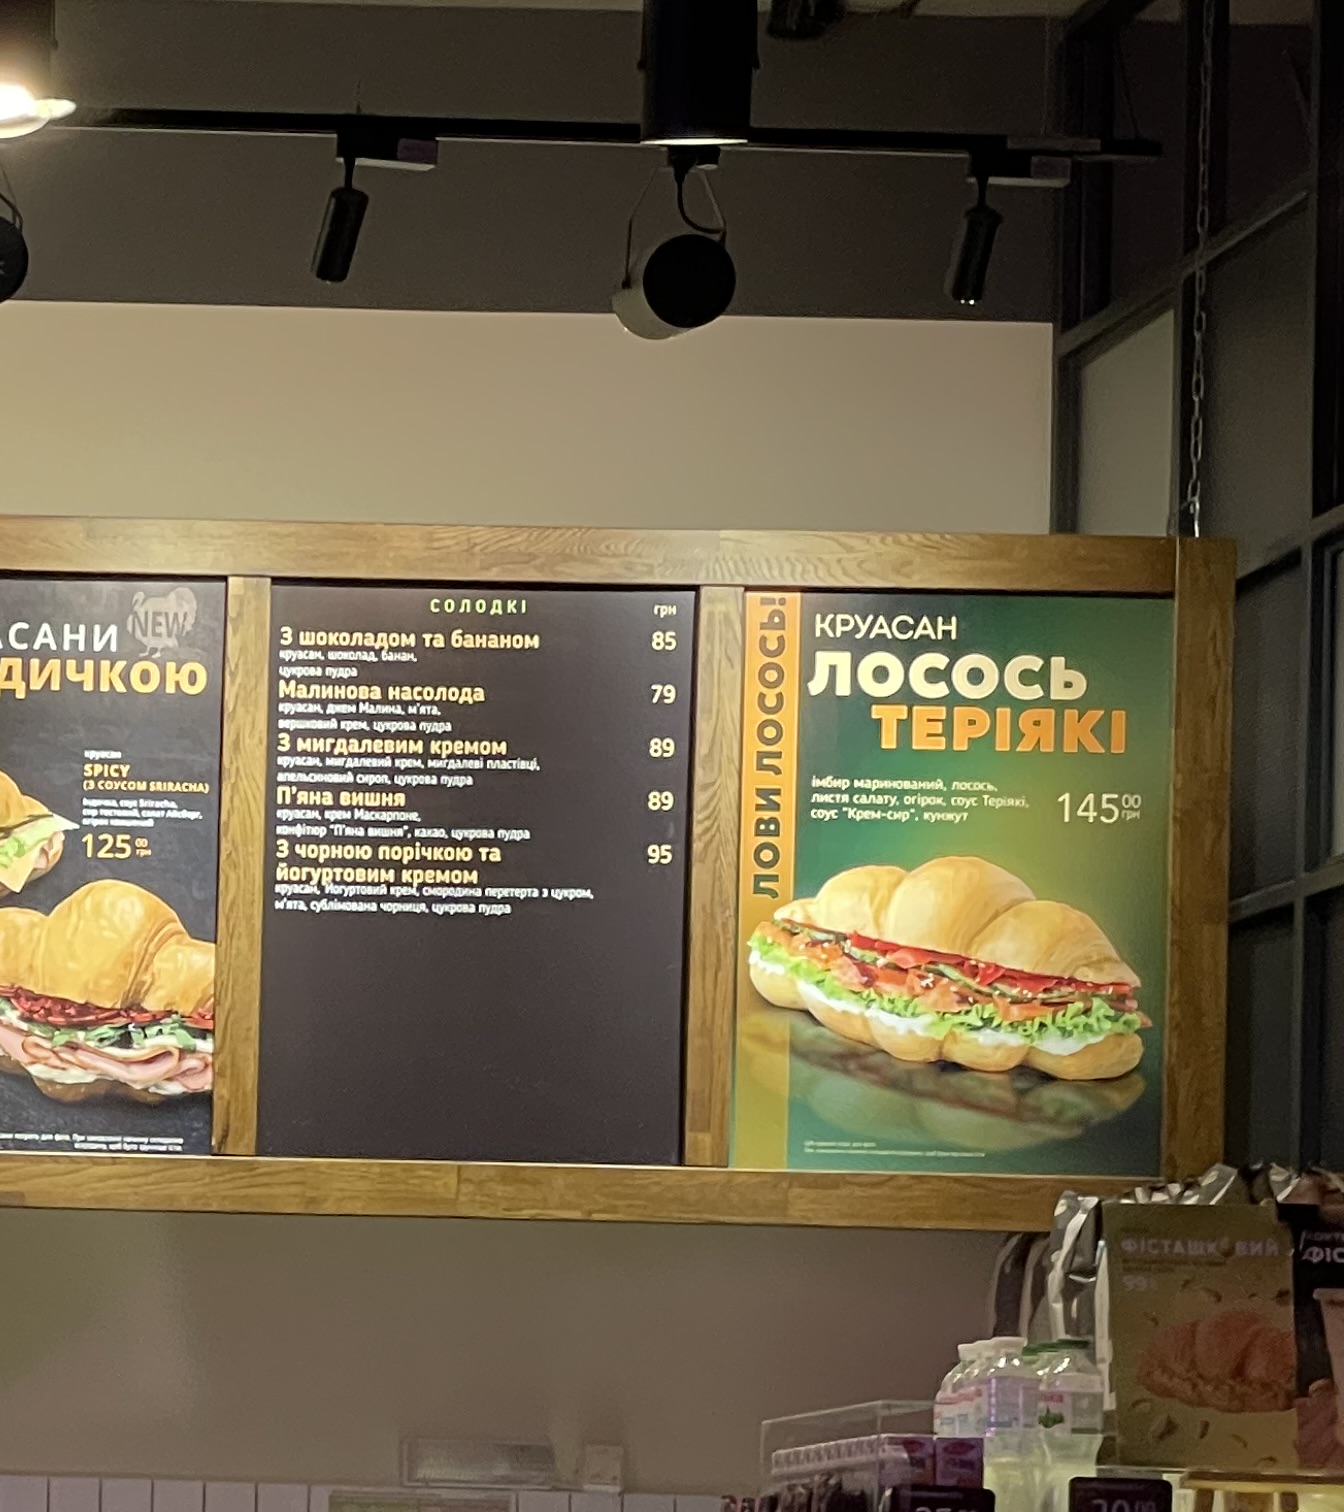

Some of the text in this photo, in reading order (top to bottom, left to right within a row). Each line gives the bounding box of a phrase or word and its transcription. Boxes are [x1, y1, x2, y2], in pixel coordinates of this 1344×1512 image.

[431, 599, 525, 615] СОЛОДКІ
[654, 605, 676, 618] грн
[130, 610, 188, 639] NEW
[815, 613, 956, 640] КРУАСАН
[279, 666, 357, 679] цукрова пудра
[808, 650, 1088, 700] ЛОСОСЬ
[279, 680, 485, 704] Малинова насолода
[651, 685, 675, 703] 79
[871, 704, 1126, 754] ТЕРІЯКІ
[753, 596, 786, 899] ЛОВИ ЛОСОСЬ!
[84, 764, 130, 777] SPICY
[340, 792, 405, 806] вишня
[648, 791, 673, 810] 89
[811, 791, 849, 804] листя
[852, 793, 899, 807] салату,
[904, 793, 946, 808] огірок,
[951, 794, 978, 808] соус
[1058, 793, 1119, 823] 145
[82, 834, 131, 858] 125
[275, 862, 478, 889] йогуртовим кремом
[1121, 1238, 1280, 1256] ФІСТАШКВИЙ
